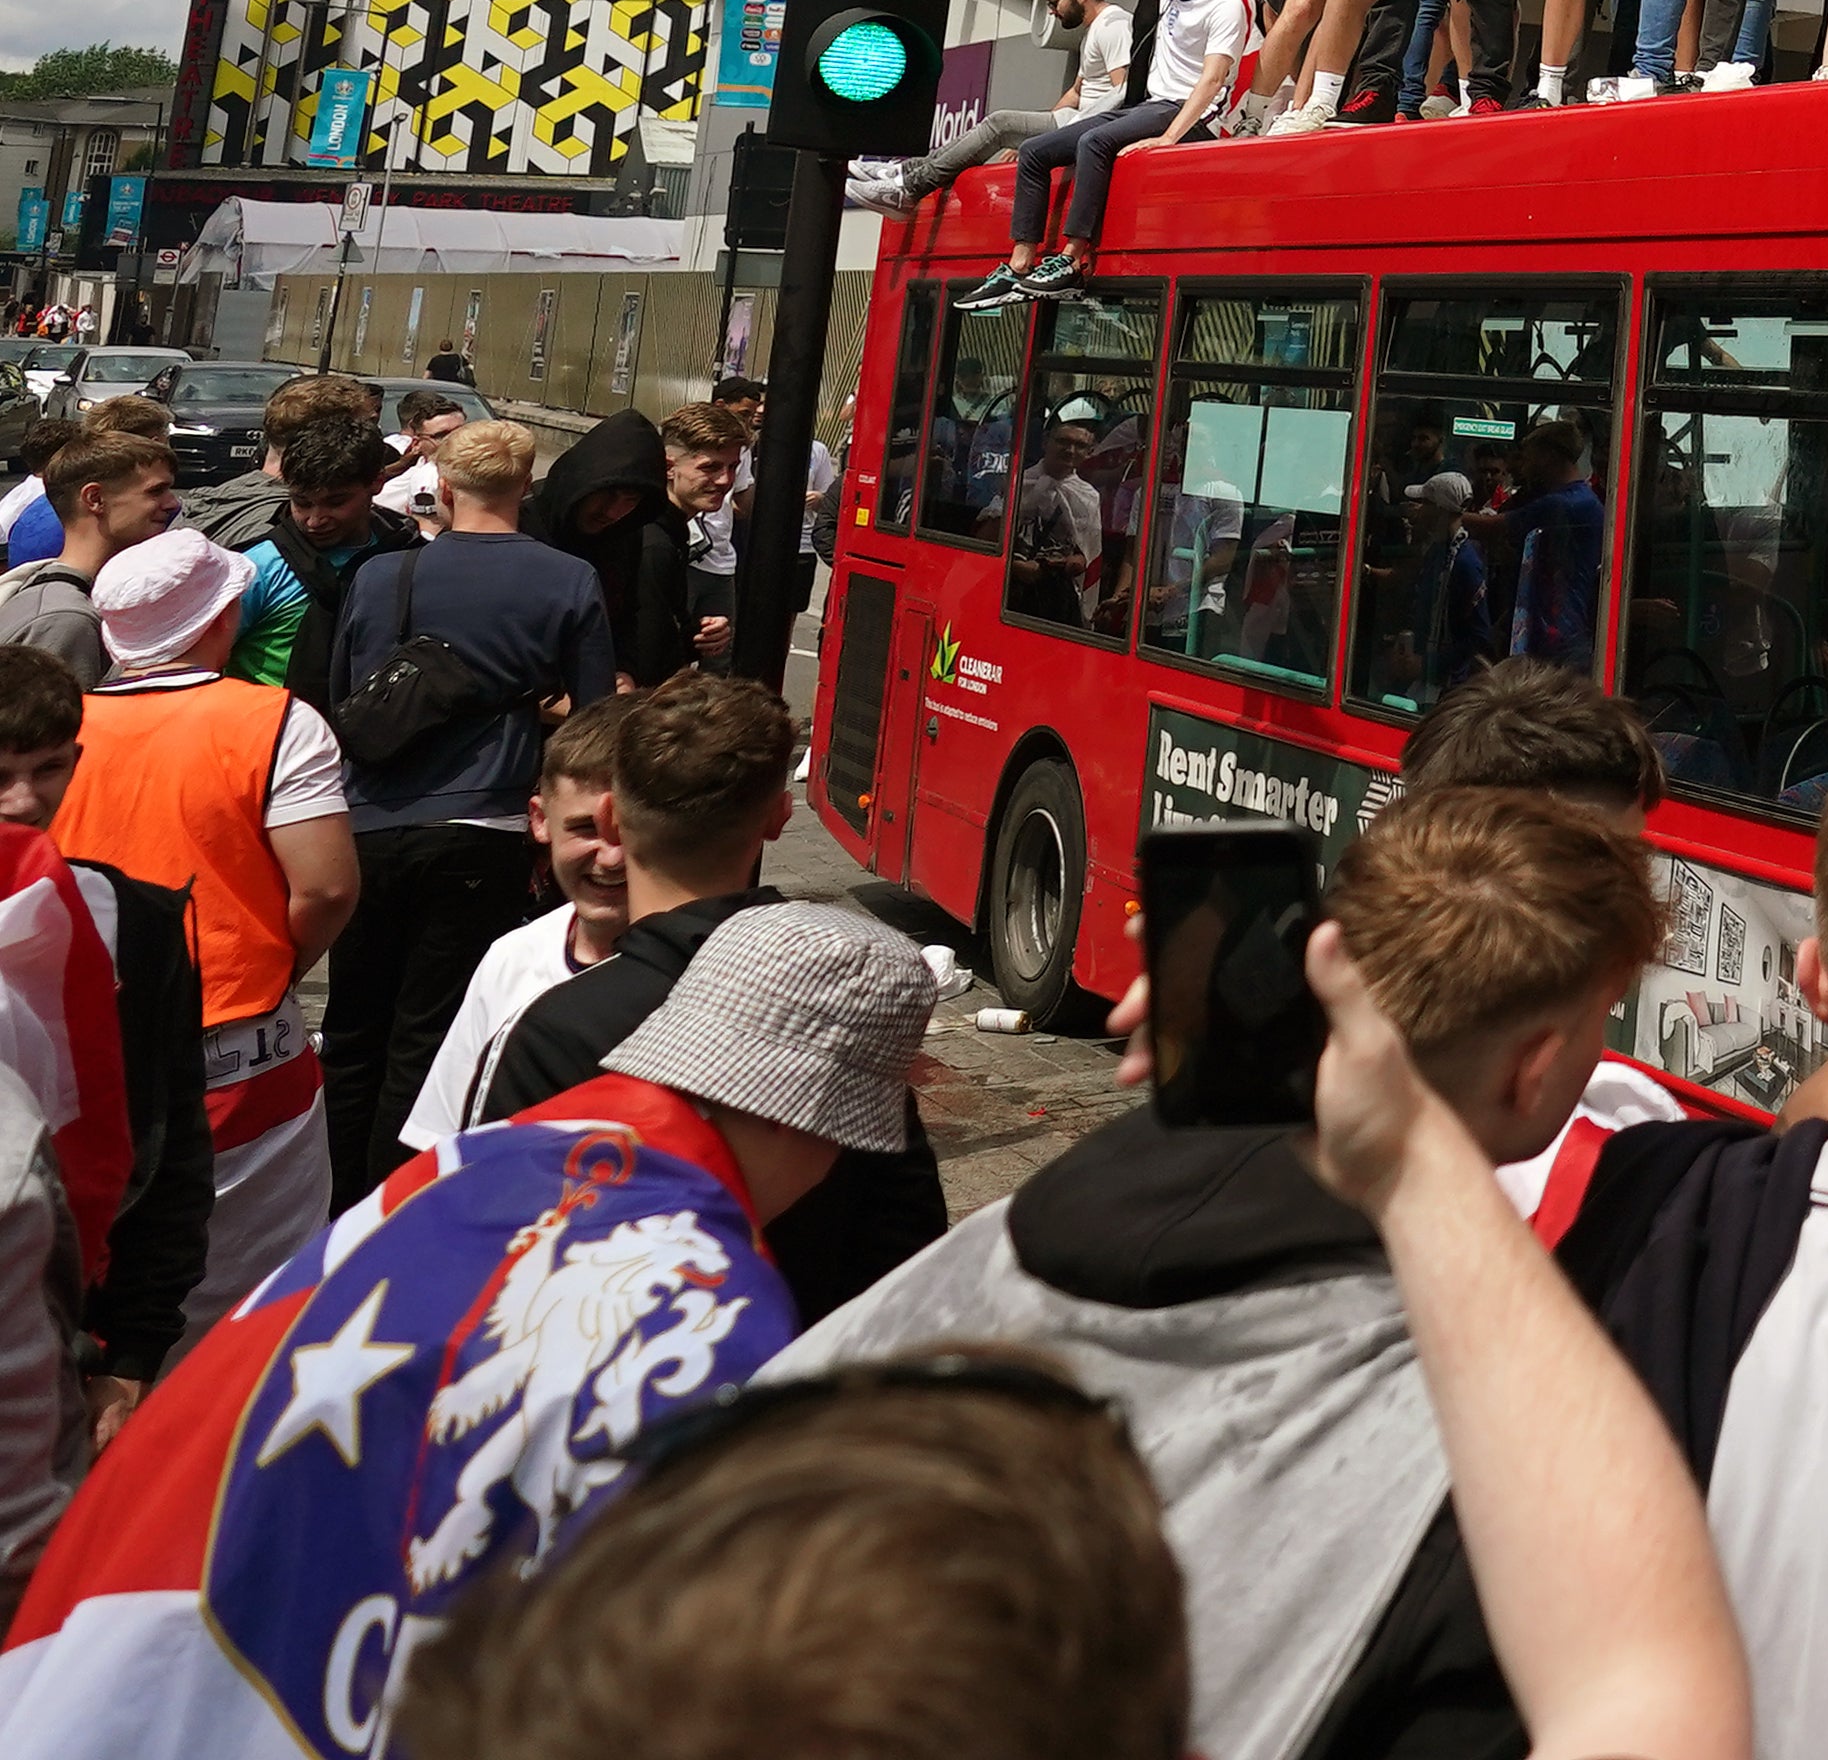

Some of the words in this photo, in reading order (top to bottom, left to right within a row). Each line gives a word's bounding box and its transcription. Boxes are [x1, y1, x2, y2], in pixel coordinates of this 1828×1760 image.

[327, 104, 349, 151] LONDON
[413, 191, 467, 210] PARK
[479, 193, 576, 214] THEATRE
[1156, 729, 1217, 795] Rent
[1215, 751, 1339, 837] Smarter
